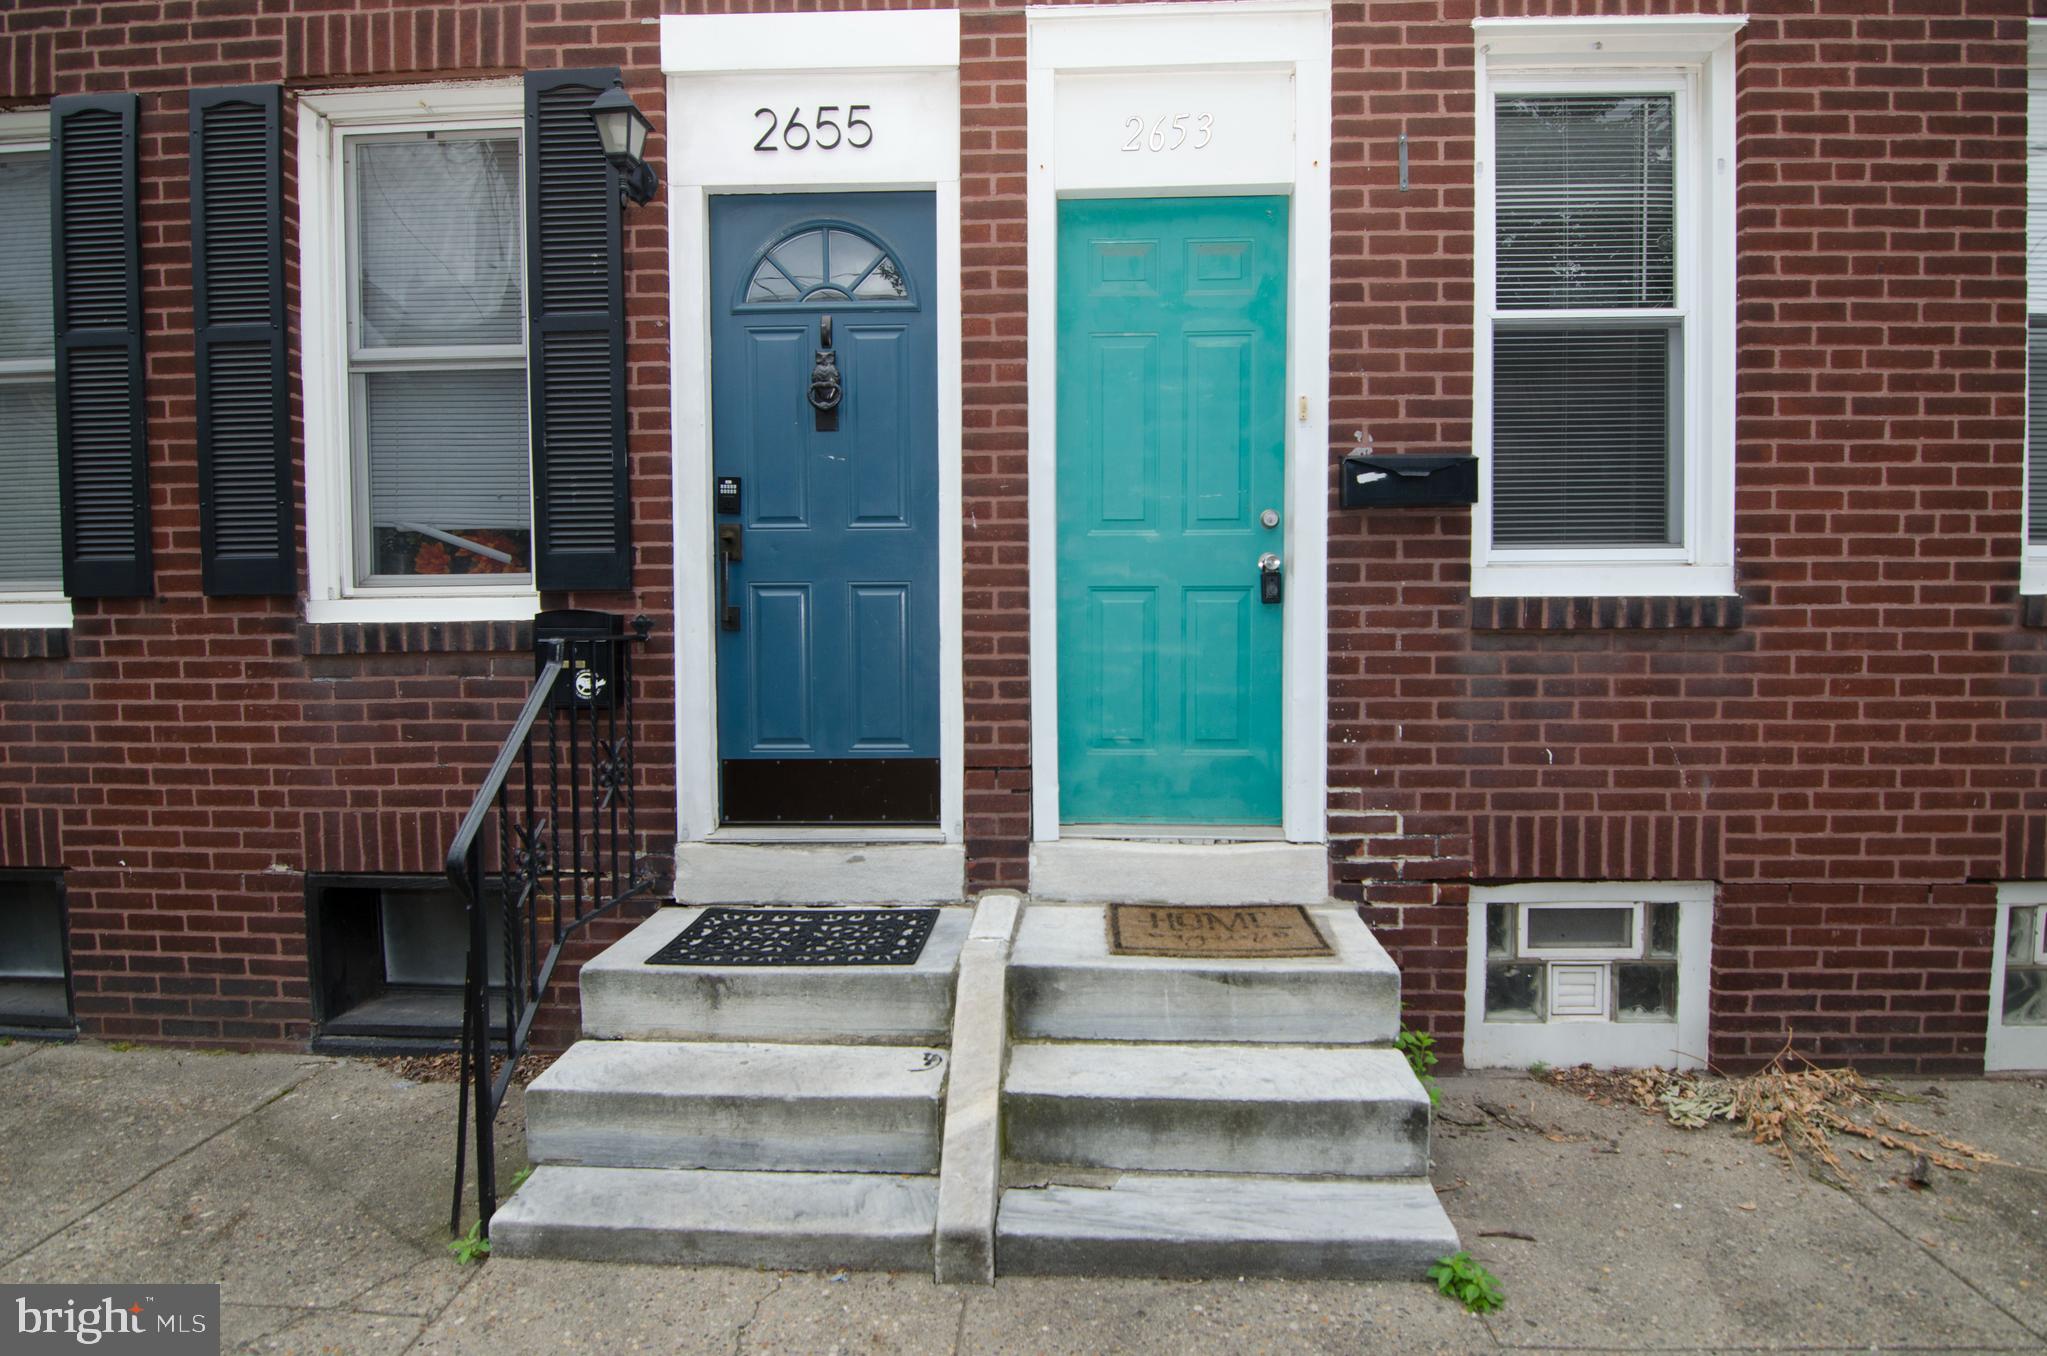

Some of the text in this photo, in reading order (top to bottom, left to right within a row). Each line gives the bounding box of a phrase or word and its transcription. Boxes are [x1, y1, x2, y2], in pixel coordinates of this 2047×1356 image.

[753, 104, 873, 151] 2655
[1120, 111, 1216, 152] 2653
[1138, 911, 1292, 932] HOME
